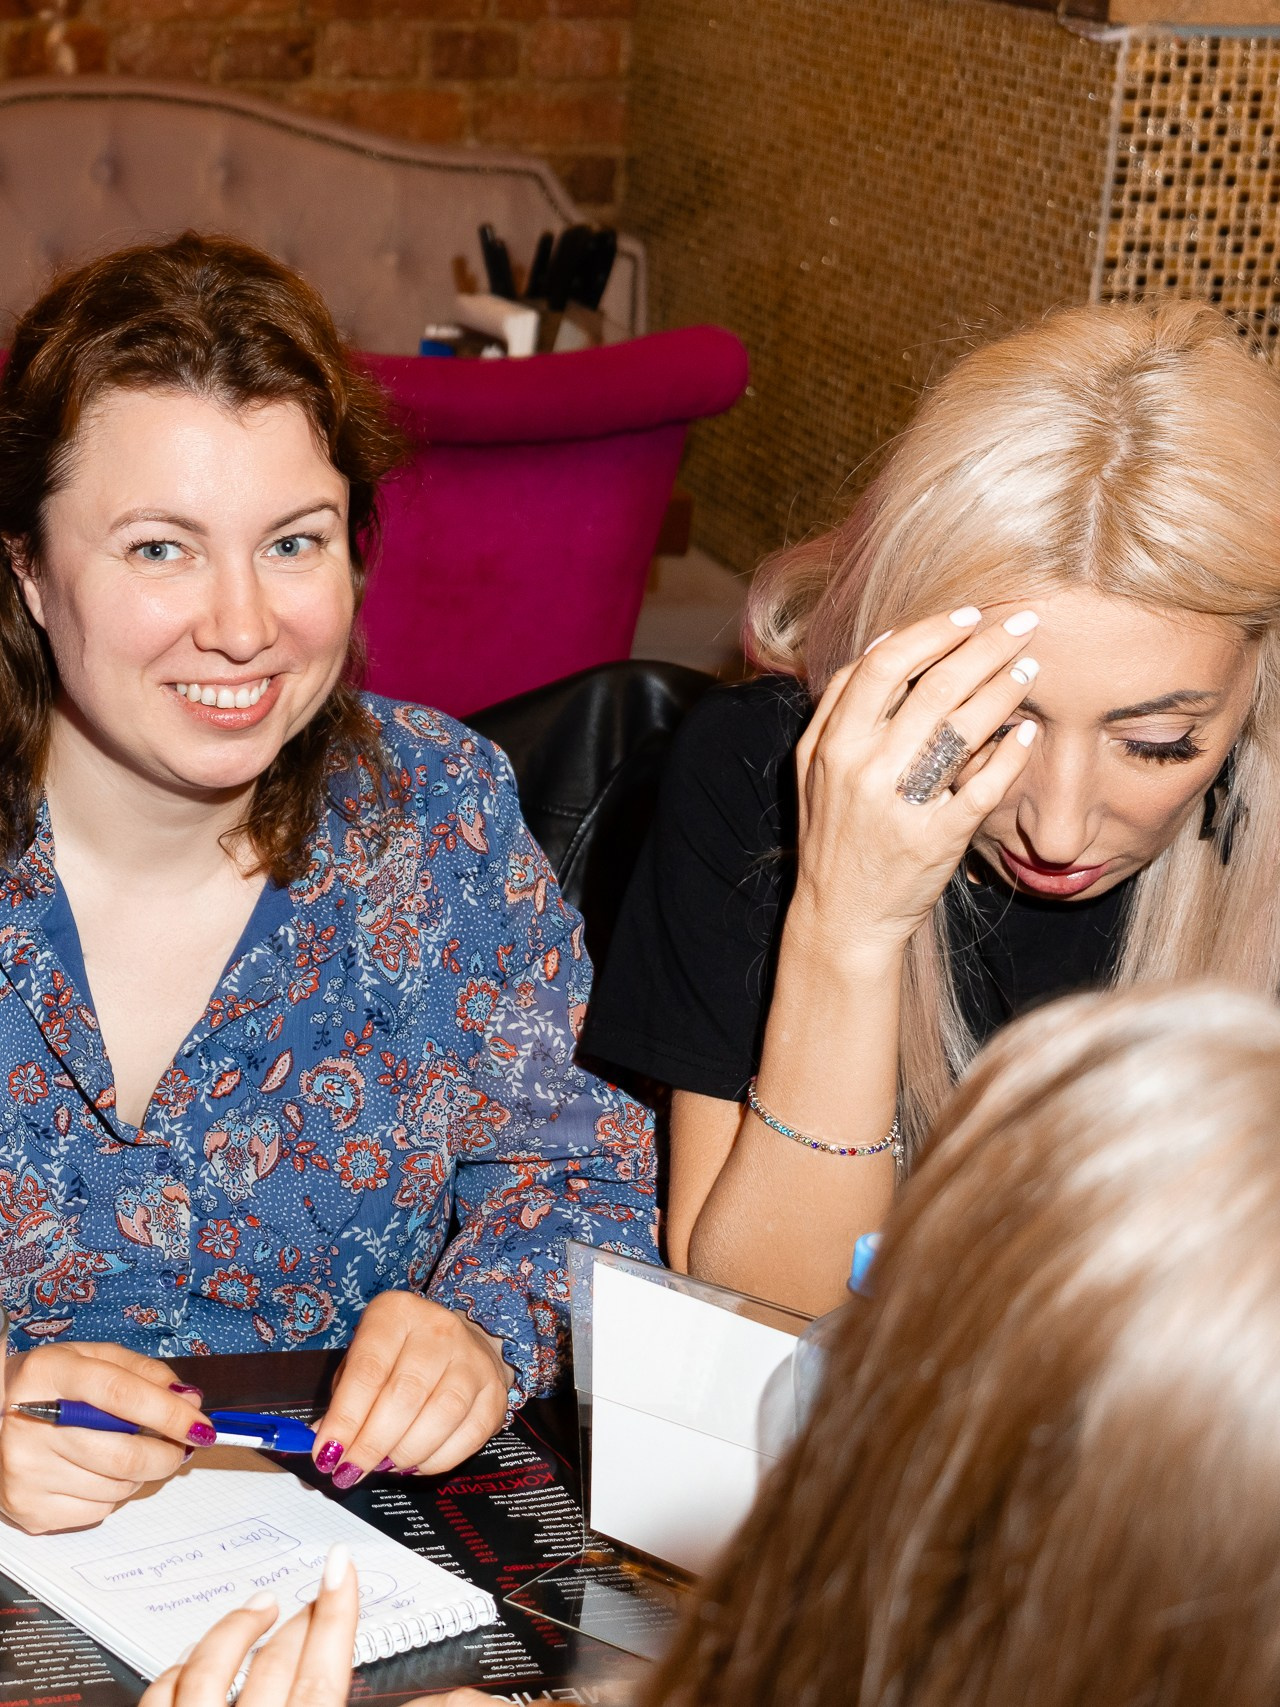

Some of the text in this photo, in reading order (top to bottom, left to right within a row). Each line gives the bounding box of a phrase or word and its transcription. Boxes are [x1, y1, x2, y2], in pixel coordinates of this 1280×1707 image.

[497, 1451, 536, 1460] Маргарита
[473, 1463, 549, 1480] КЛАССИЧЕСКИЕ
[436, 1471, 555, 1496] КОКТЕЙЛИ
[507, 1485, 565, 1498] Безалкогольное
[514, 1492, 569, 1504] Императорский
[32, 1693, 82, 1704] БЕЛОЕ
